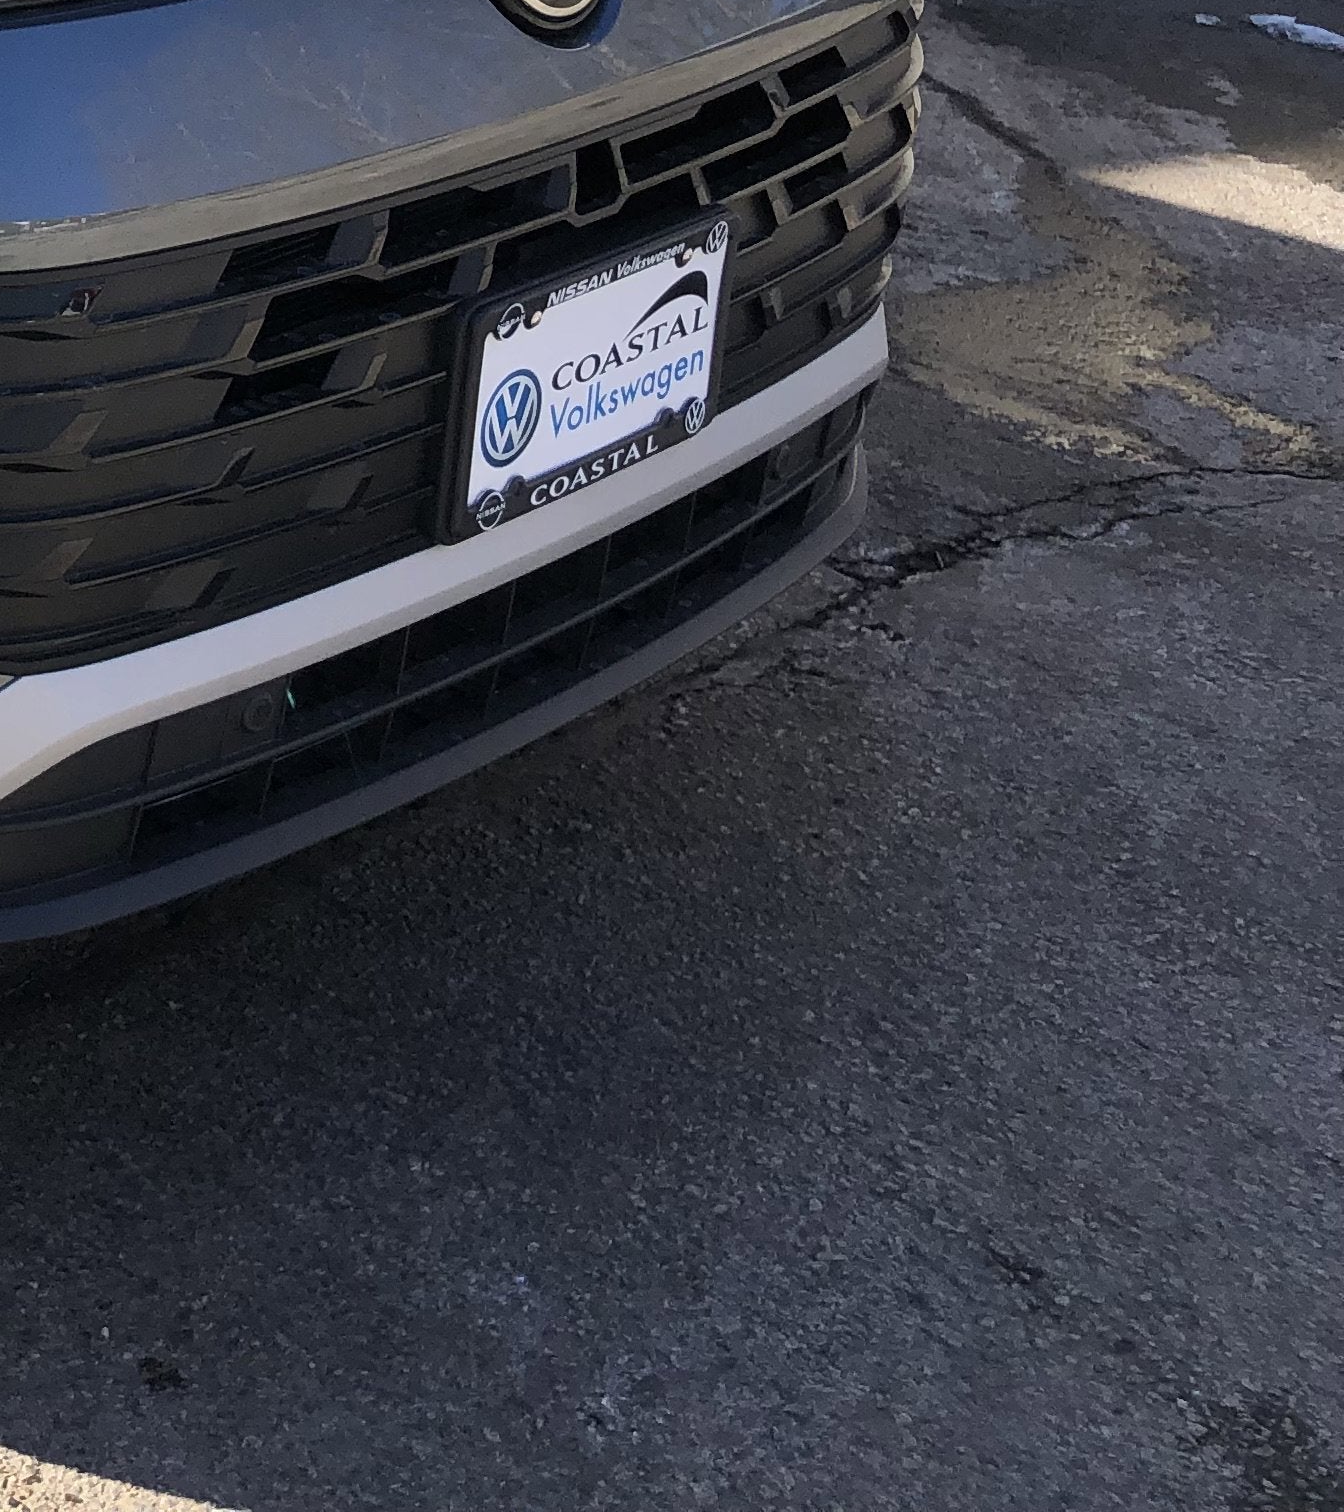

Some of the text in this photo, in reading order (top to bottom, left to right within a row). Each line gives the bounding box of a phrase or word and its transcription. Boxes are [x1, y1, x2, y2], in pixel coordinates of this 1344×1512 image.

[546, 242, 686, 308] NISSAN Volkswagen
[551, 306, 709, 391] COASTAL
[550, 349, 704, 439] Volkswagen
[530, 434, 659, 506] COASTAL
